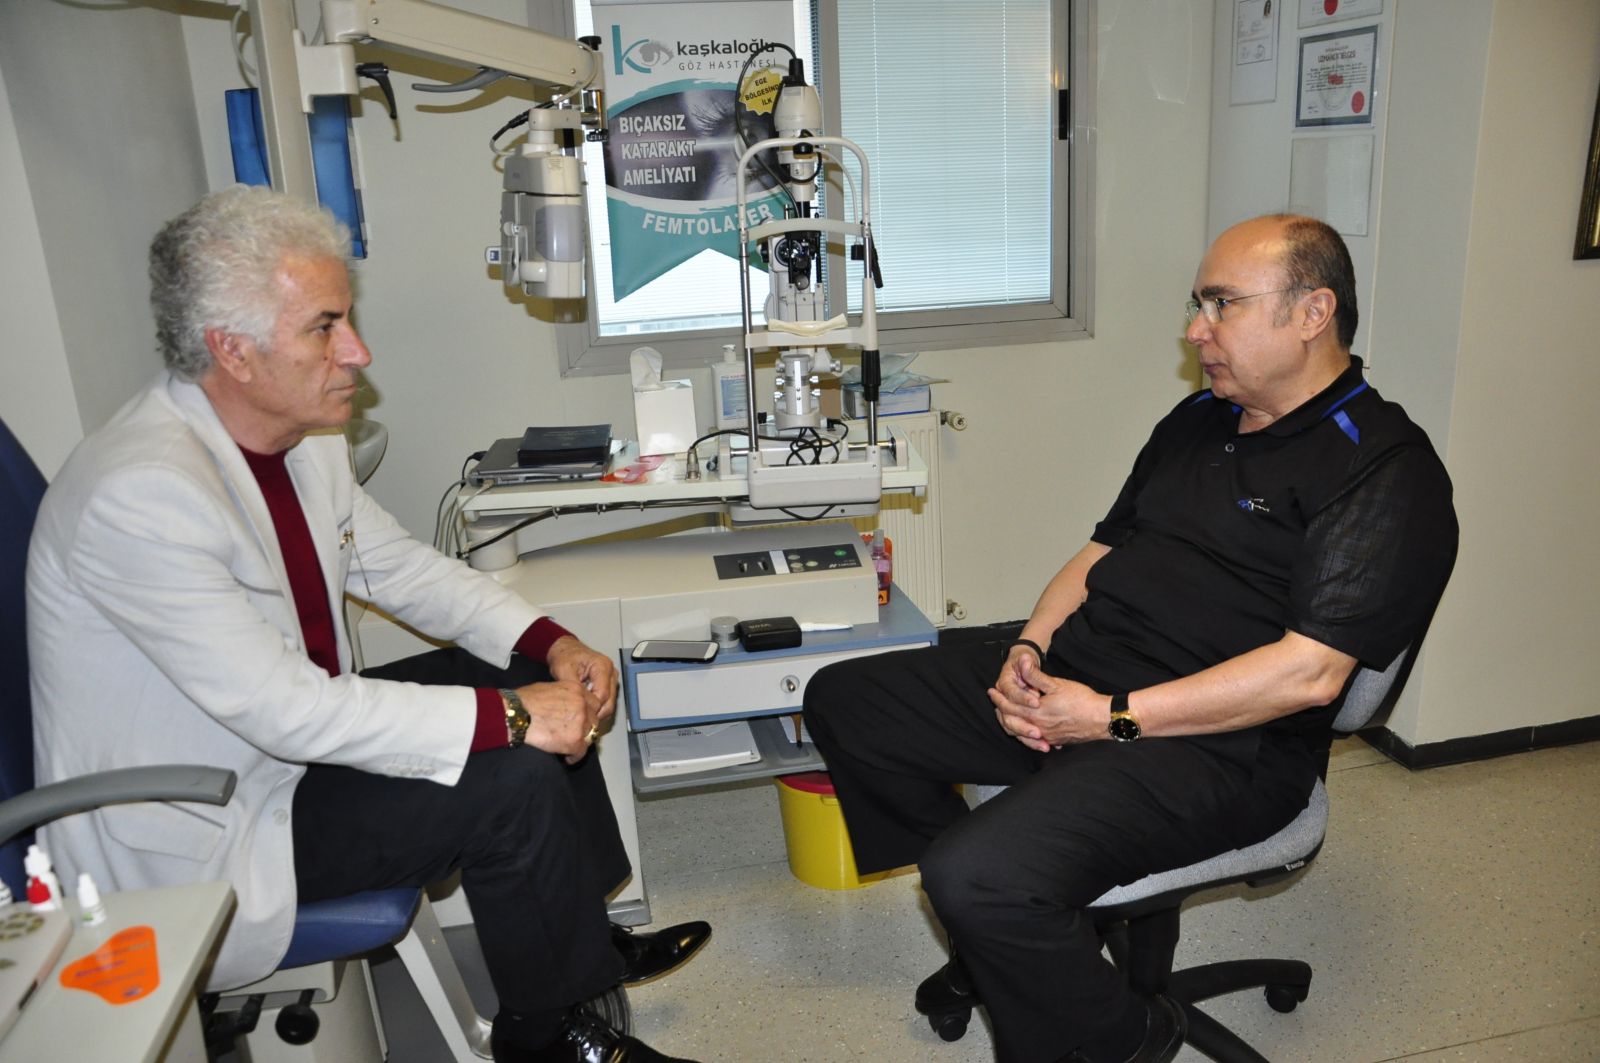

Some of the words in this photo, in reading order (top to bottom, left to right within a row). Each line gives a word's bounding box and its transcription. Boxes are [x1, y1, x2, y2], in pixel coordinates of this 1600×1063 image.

[677, 38, 775, 57] kaşkaloğlu
[679, 60, 702, 71] GÖZ
[754, 76, 768, 87] EGE
[744, 83, 780, 101] BÖLGESİND
[761, 97, 773, 106] İLK
[619, 114, 686, 136] BIÇAKSIZ
[621, 140, 697, 160] KATARAKT
[623, 164, 697, 186] AMELİYATI
